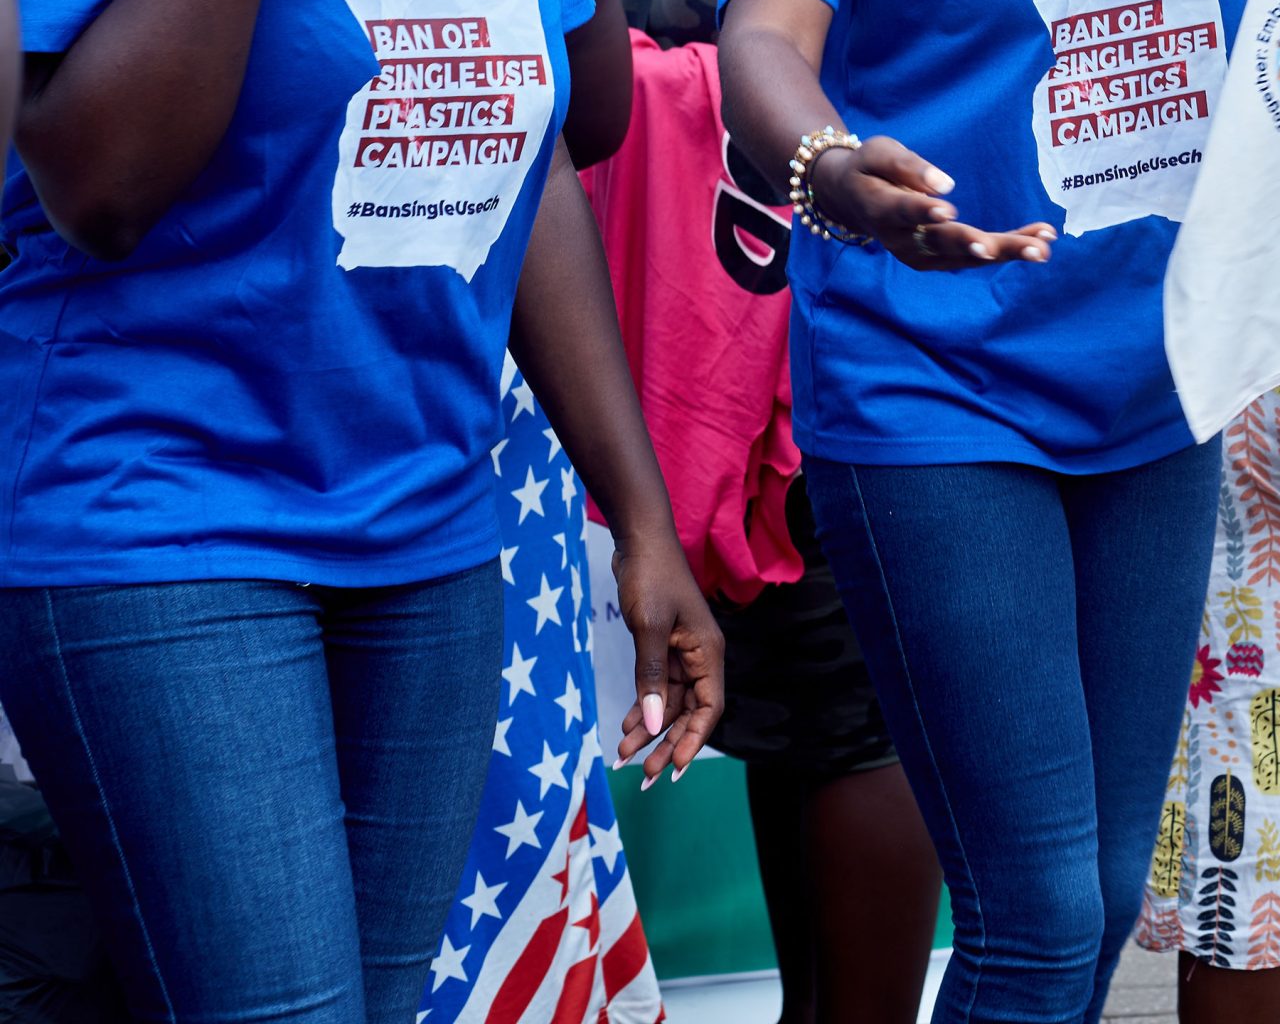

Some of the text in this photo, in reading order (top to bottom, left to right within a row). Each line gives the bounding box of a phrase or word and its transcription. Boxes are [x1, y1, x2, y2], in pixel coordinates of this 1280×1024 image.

[373, 23, 481, 52] BAN OF
[1054, 5, 1155, 46] BAN OF
[1052, 28, 1210, 79] SINGLE-USE
[377, 61, 539, 92] SINGLE-USE
[1053, 67, 1182, 113] PLASTICS
[370, 99, 509, 131] PLASTICS
[1057, 96, 1199, 148] CAMPAIGN
[360, 137, 519, 169] CAMPAIGN
[1061, 149, 1202, 191] #BanSingleUseGh
[347, 195, 500, 219] #BanSingleUseGh
